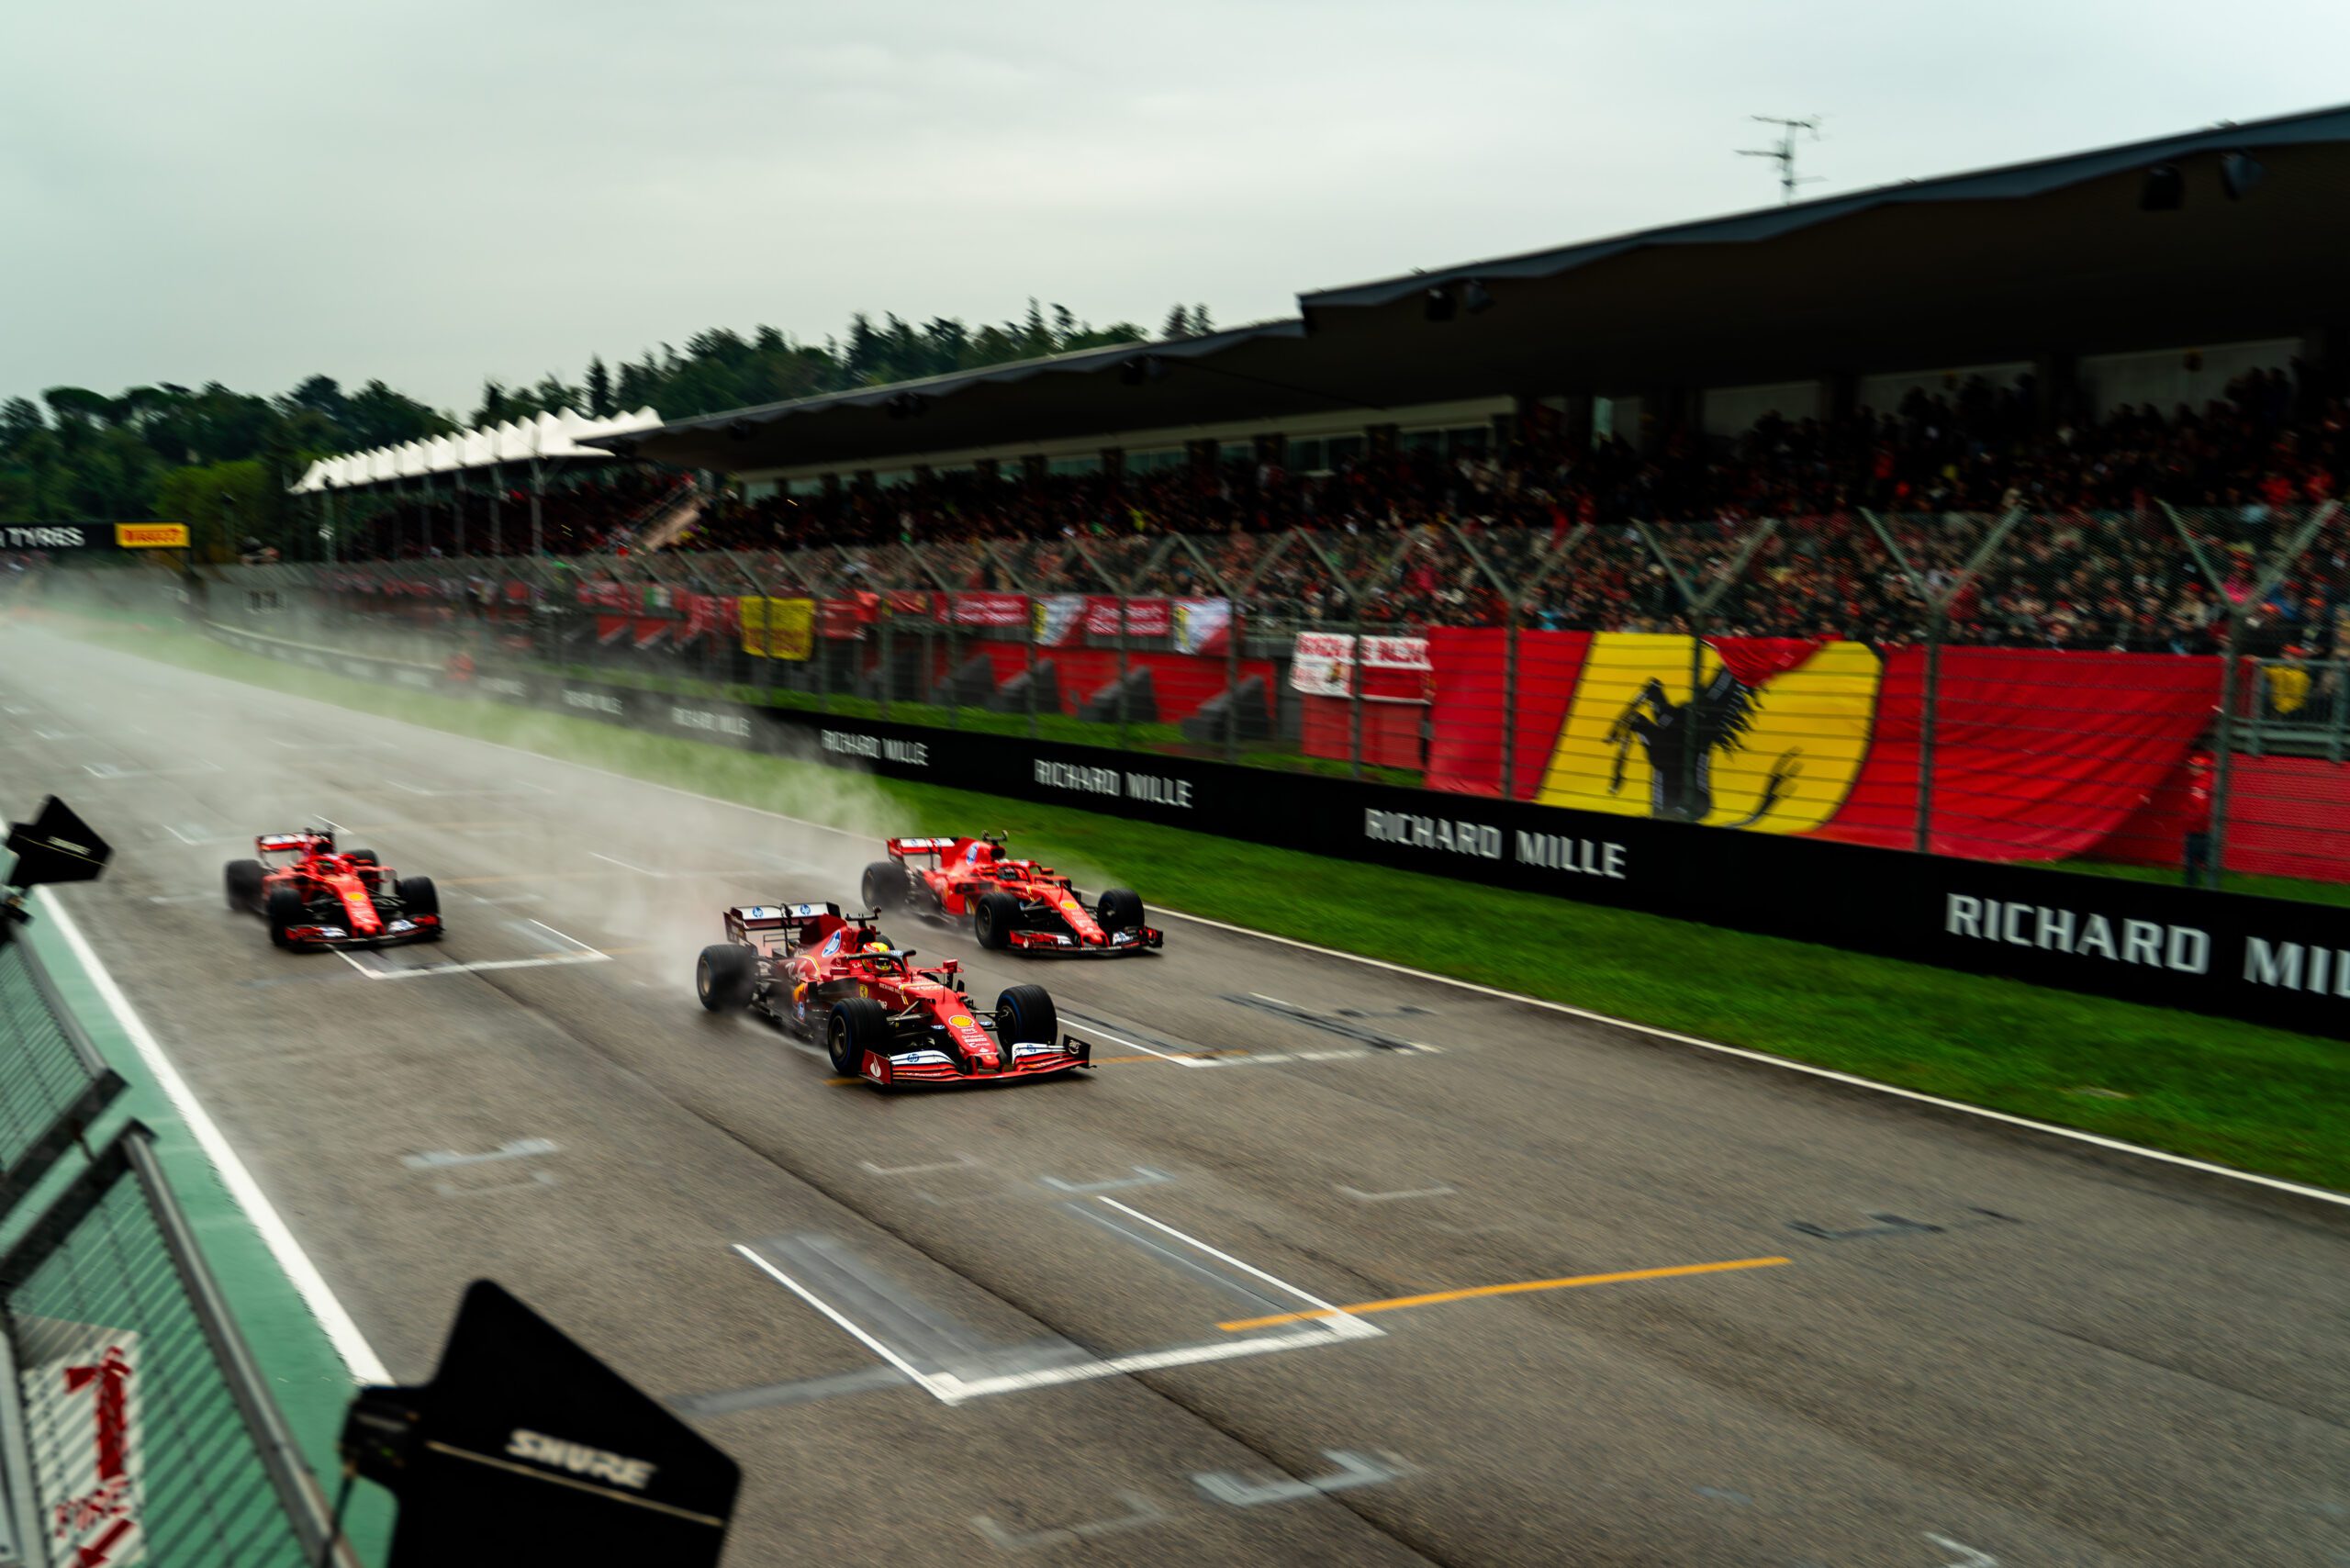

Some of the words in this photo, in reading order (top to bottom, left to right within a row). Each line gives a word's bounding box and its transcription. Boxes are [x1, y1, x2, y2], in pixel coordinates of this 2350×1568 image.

[5, 526, 85, 548] TYRES
[822, 729, 881, 760] RICHARD
[882, 737, 929, 767] MILLE
[1034, 758, 1120, 797] RICHARD
[1125, 771, 1193, 809] MILLE
[1365, 807, 1503, 859] RICHARD
[1516, 829, 1627, 879] MILLE
[1945, 892, 2210, 975] RICHARD
[505, 1428, 660, 1490] SHURE
